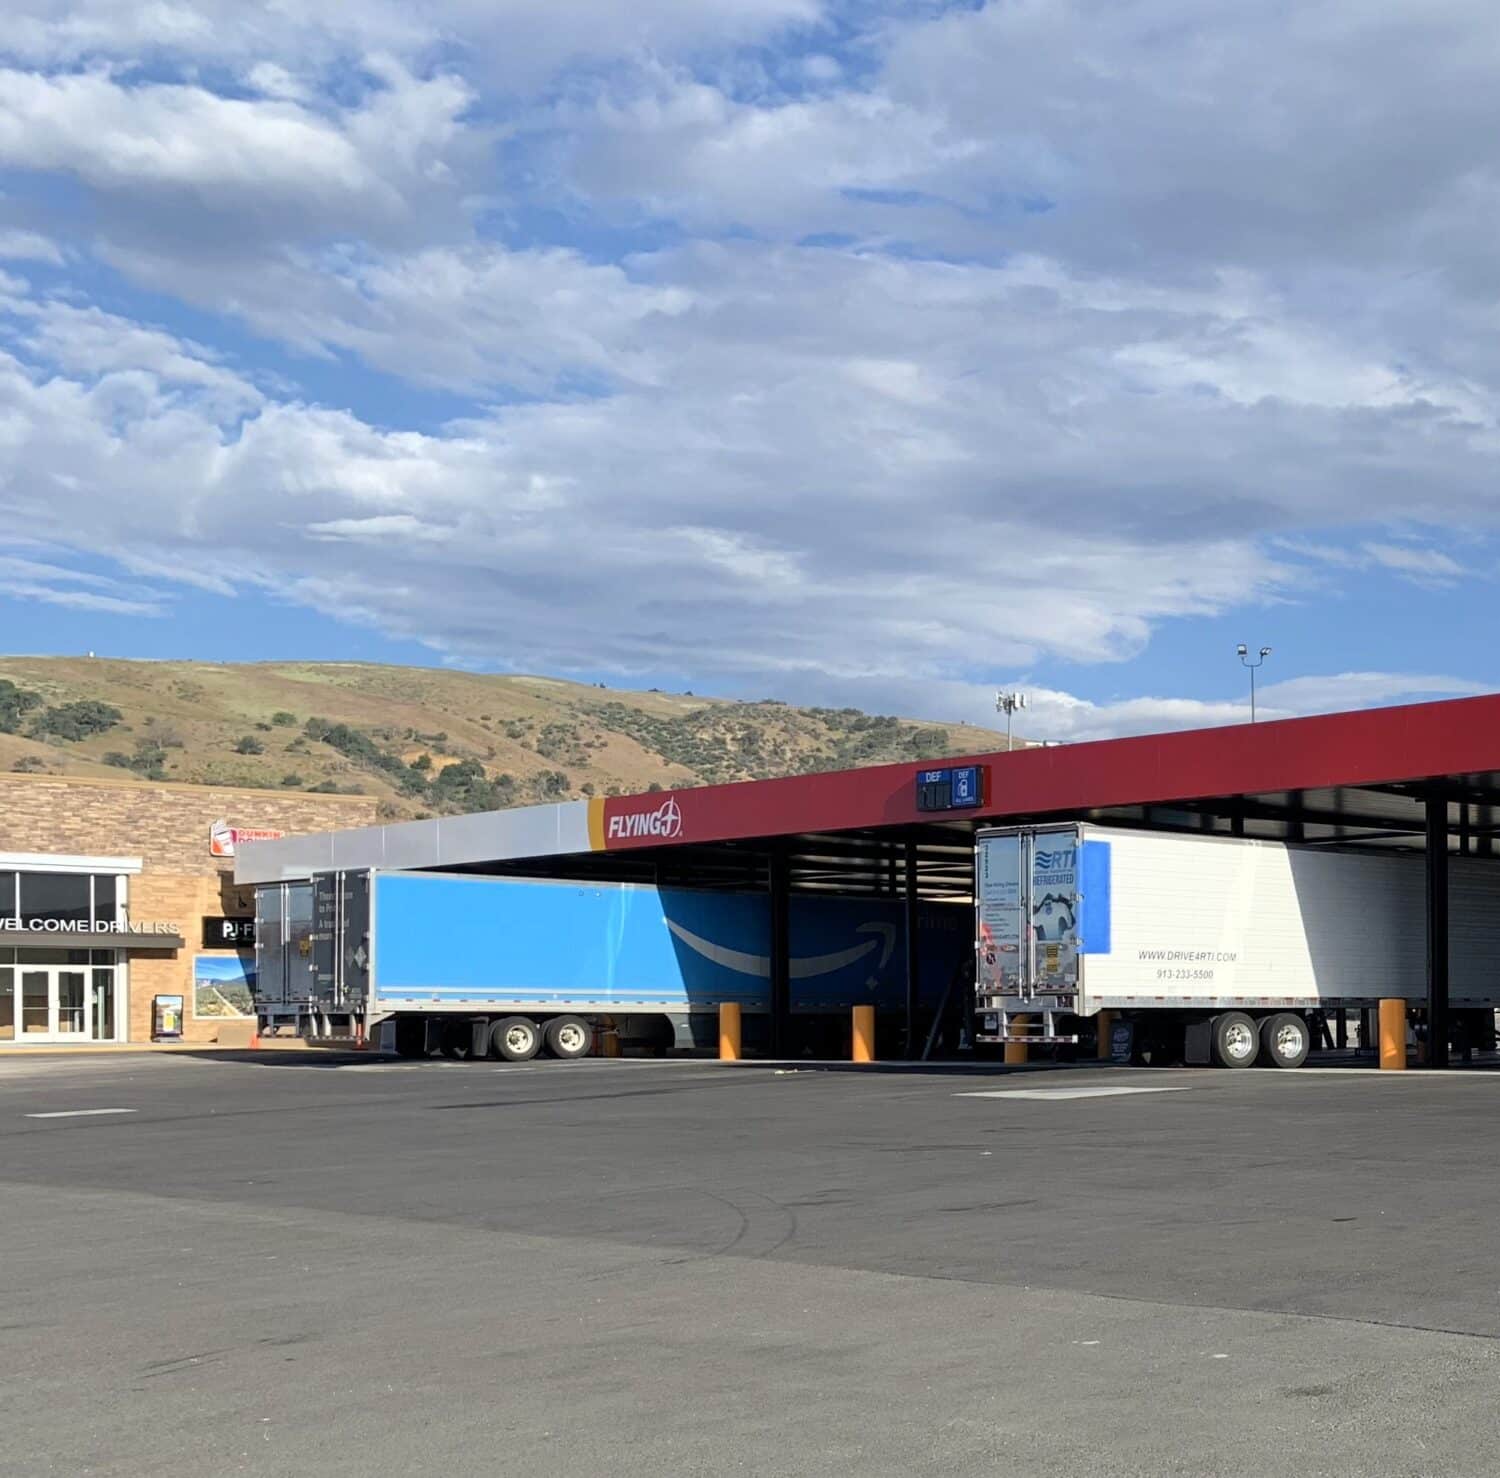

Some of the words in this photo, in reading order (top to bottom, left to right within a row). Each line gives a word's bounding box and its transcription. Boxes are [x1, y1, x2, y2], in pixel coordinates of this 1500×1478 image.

[926, 771, 942, 782] DEF
[958, 770, 969, 779] DEF
[608, 811, 661, 838] FLYING
[1051, 849, 1077, 869] RTI
[0, 918, 89, 932] ELCOME
[96, 920, 180, 933] DRIVERS
[1138, 950, 1237, 962] WWW.DRIVE4RTI.COM
[1156, 967, 1214, 979] 913-233-5500
